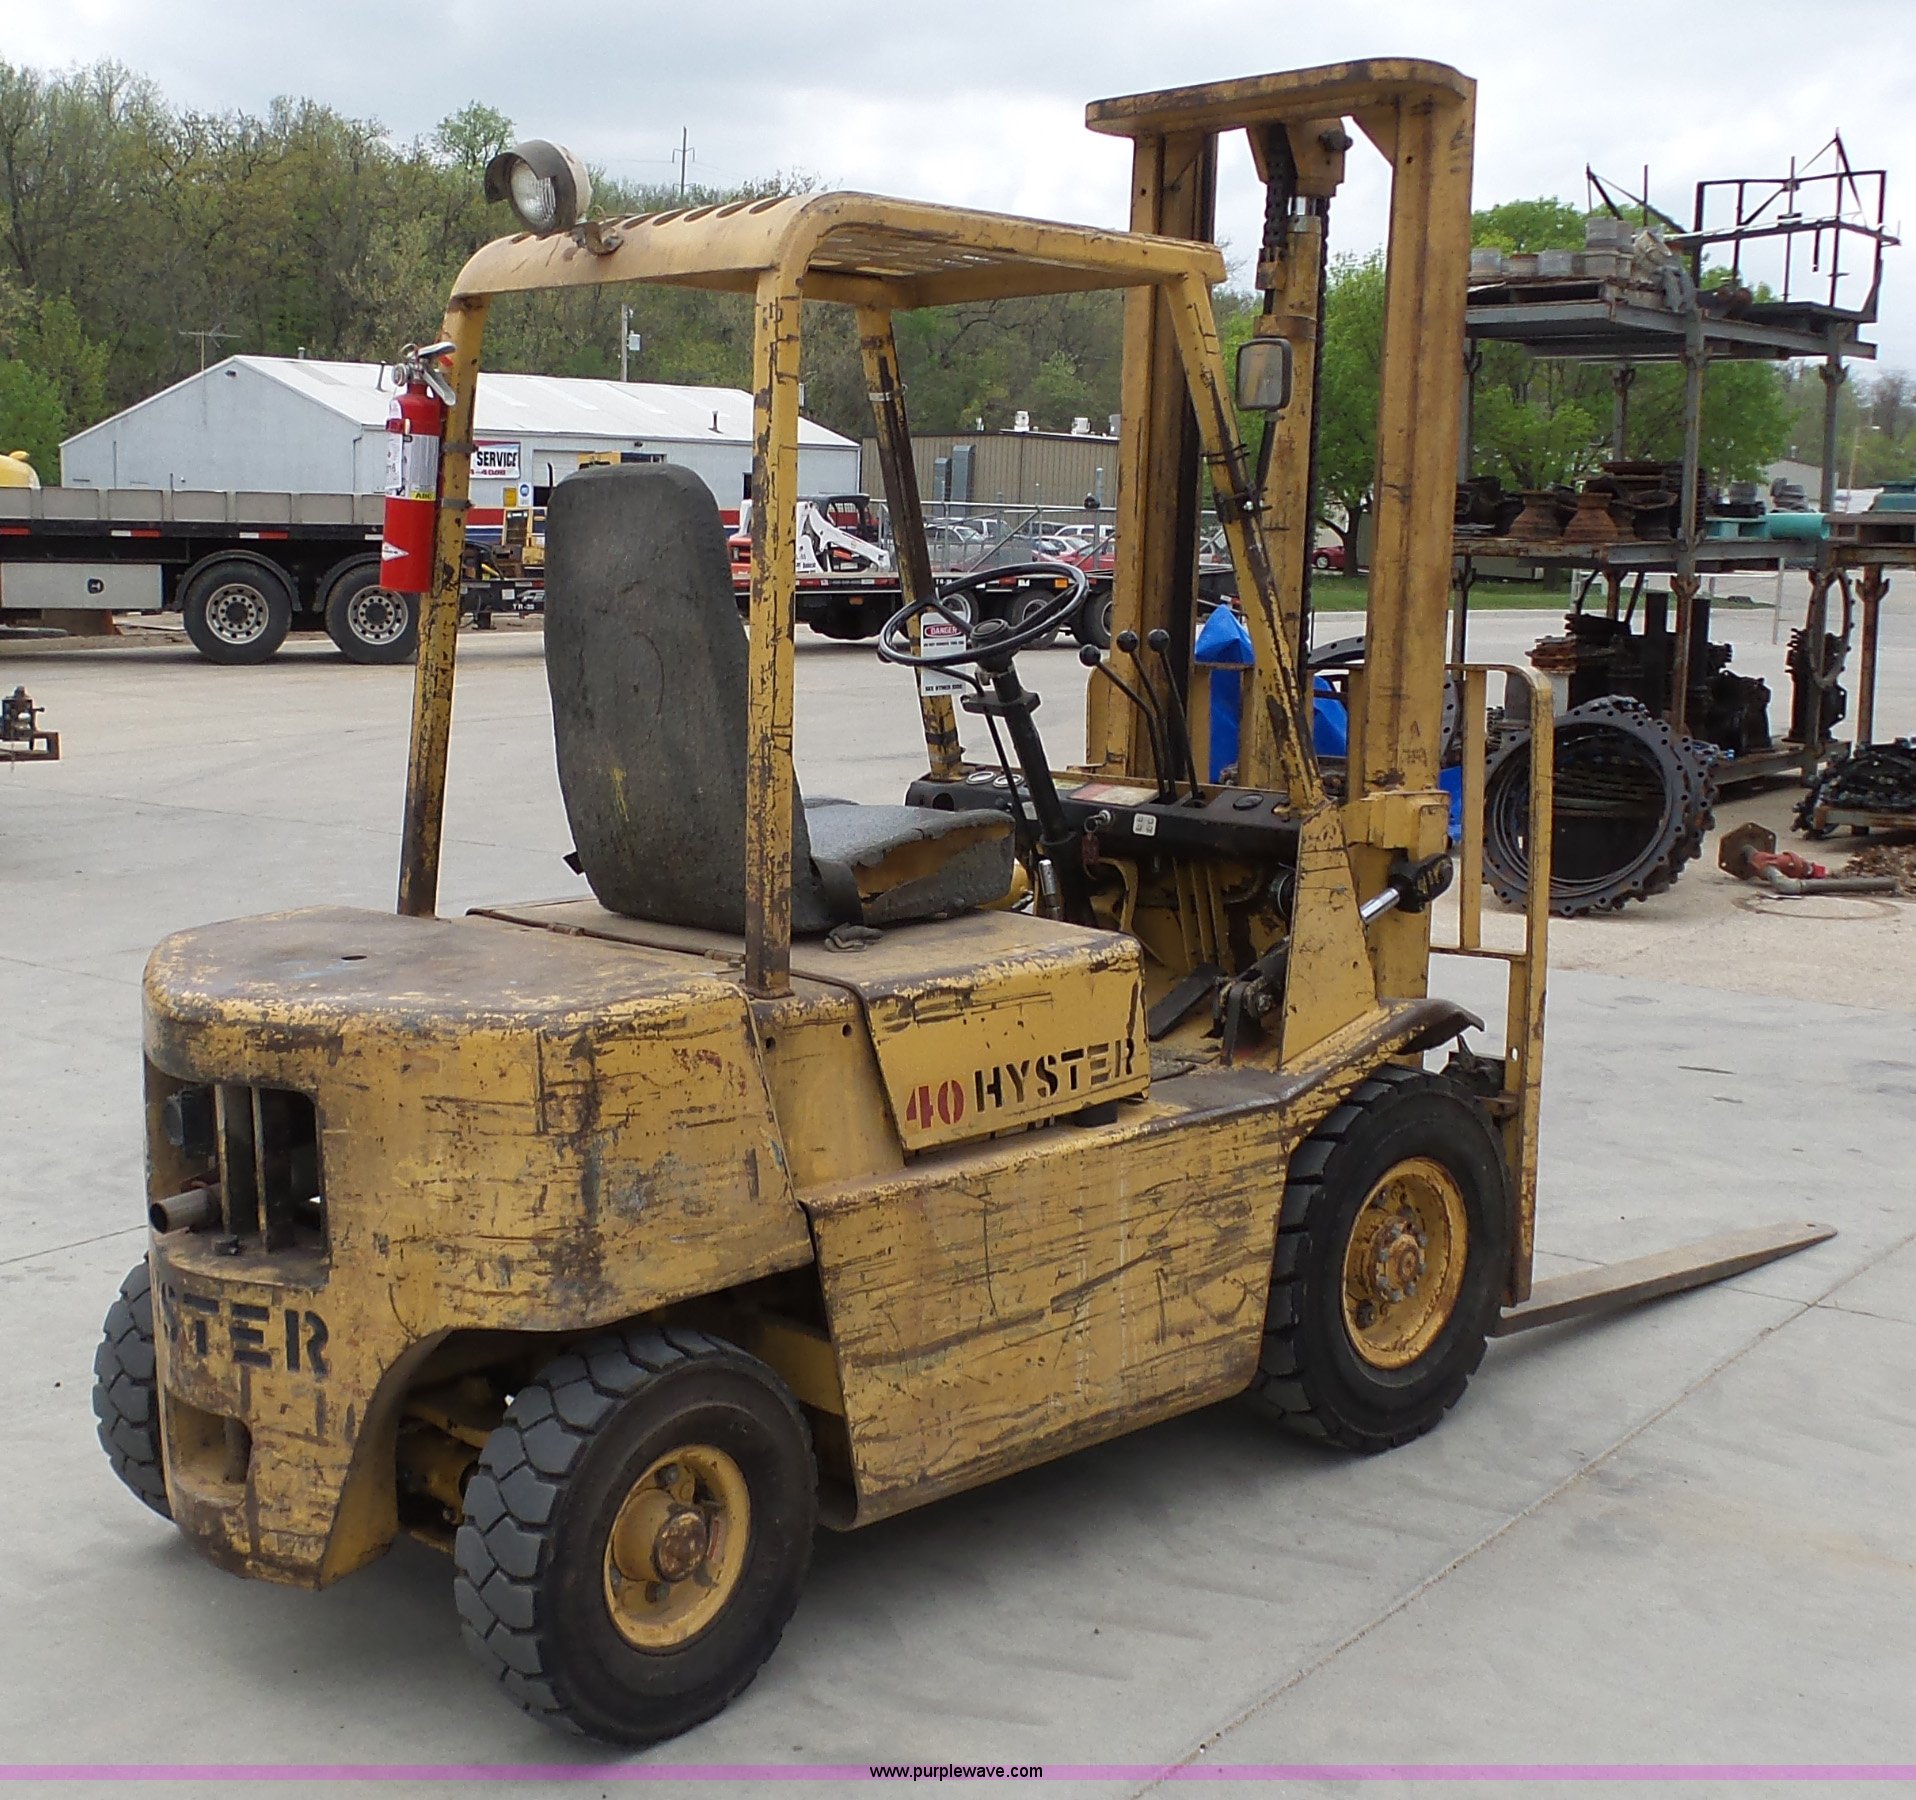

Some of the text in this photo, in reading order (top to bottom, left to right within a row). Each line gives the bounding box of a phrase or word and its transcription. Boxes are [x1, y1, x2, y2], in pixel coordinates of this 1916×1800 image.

[476, 451, 517, 467] SERVICE
[930, 626, 957, 635] DANGER
[905, 1037, 1135, 1129] 40 HYSTER
